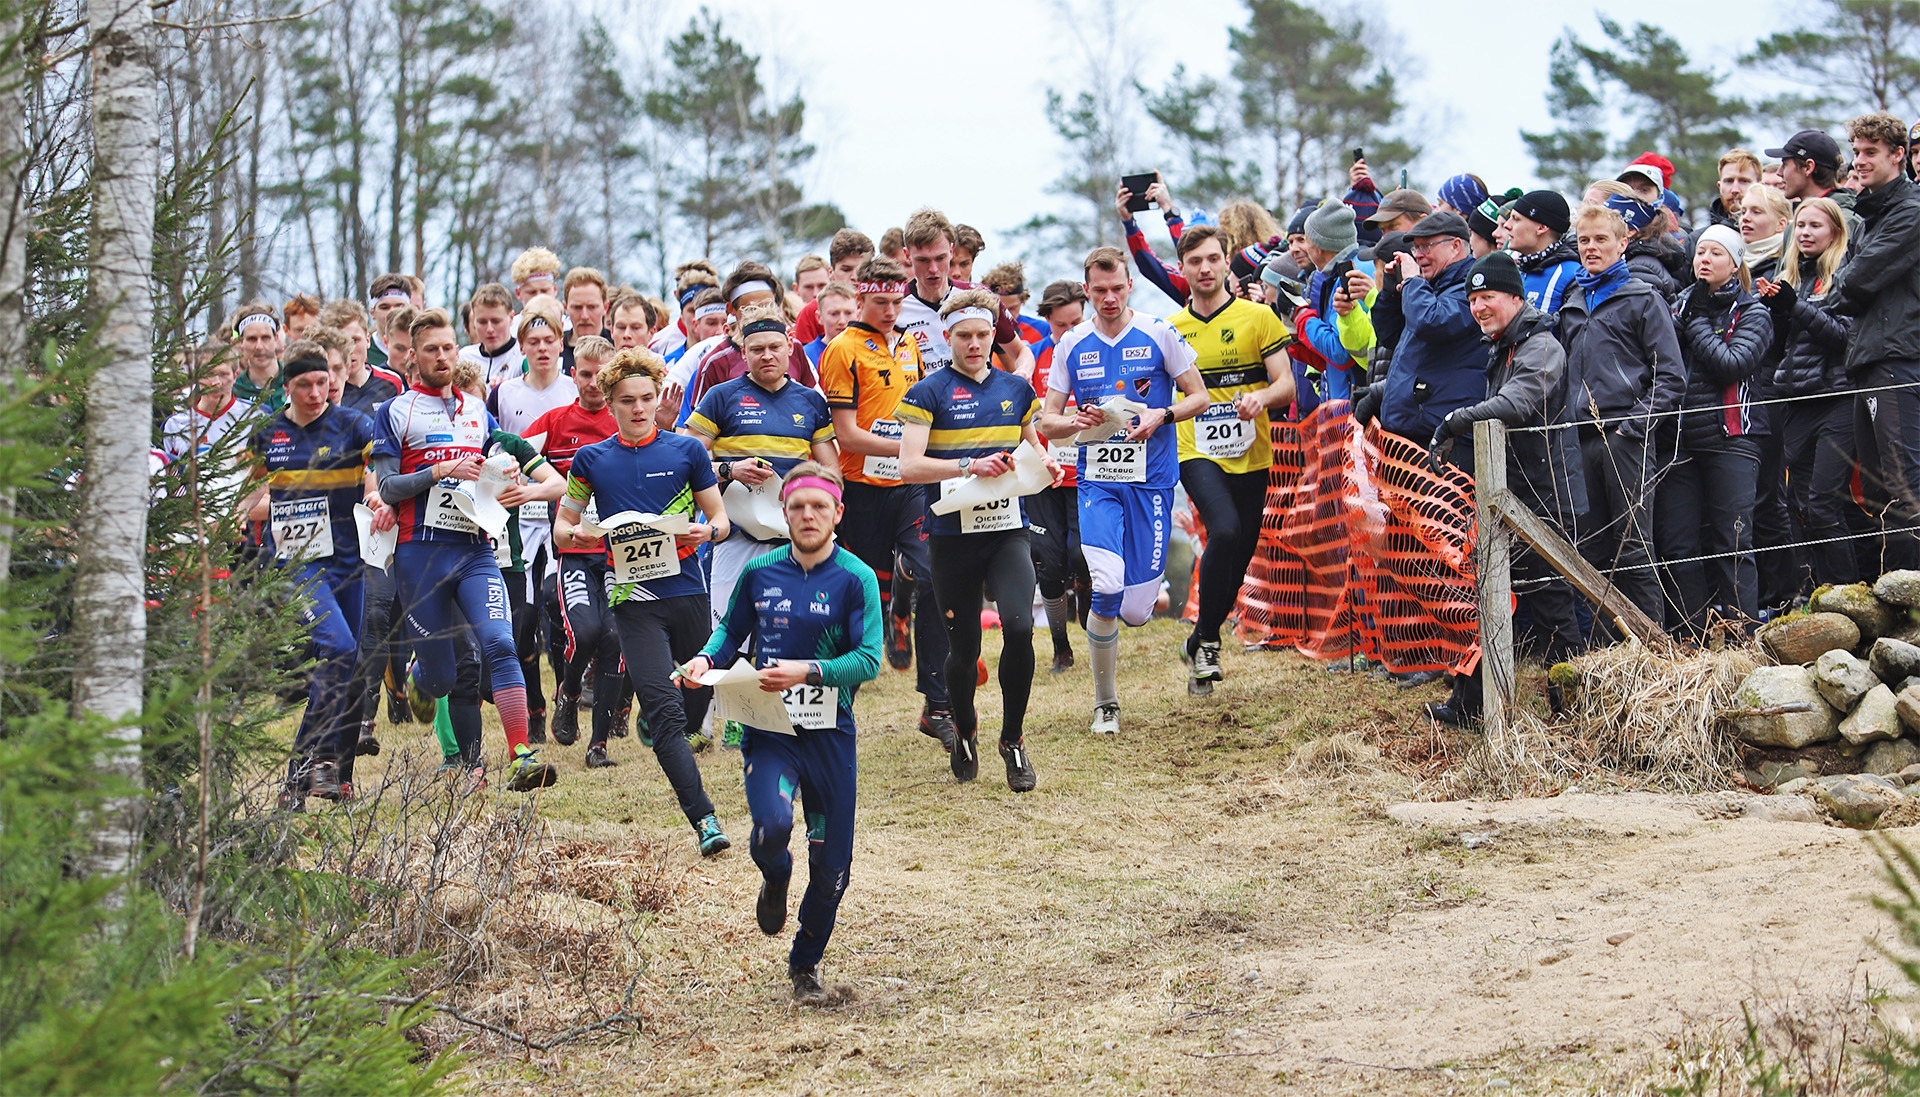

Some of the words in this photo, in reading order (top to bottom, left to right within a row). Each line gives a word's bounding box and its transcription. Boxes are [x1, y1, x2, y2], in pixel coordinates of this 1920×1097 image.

[1124, 347, 1148, 358] EKSX
[1206, 422, 1243, 440] 201
[1097, 447, 1135, 463] 202
[1152, 494, 1162, 517] OK
[281, 521, 319, 541] 227
[623, 541, 663, 563] 247
[1150, 520, 1163, 572] ORION
[637, 562, 667, 572] ICEBUG
[563, 569, 591, 611] SAIK
[486, 586, 504, 620] BYÅSEN
[407, 613, 431, 637] TRIMTEX
[784, 687, 824, 705] 212
